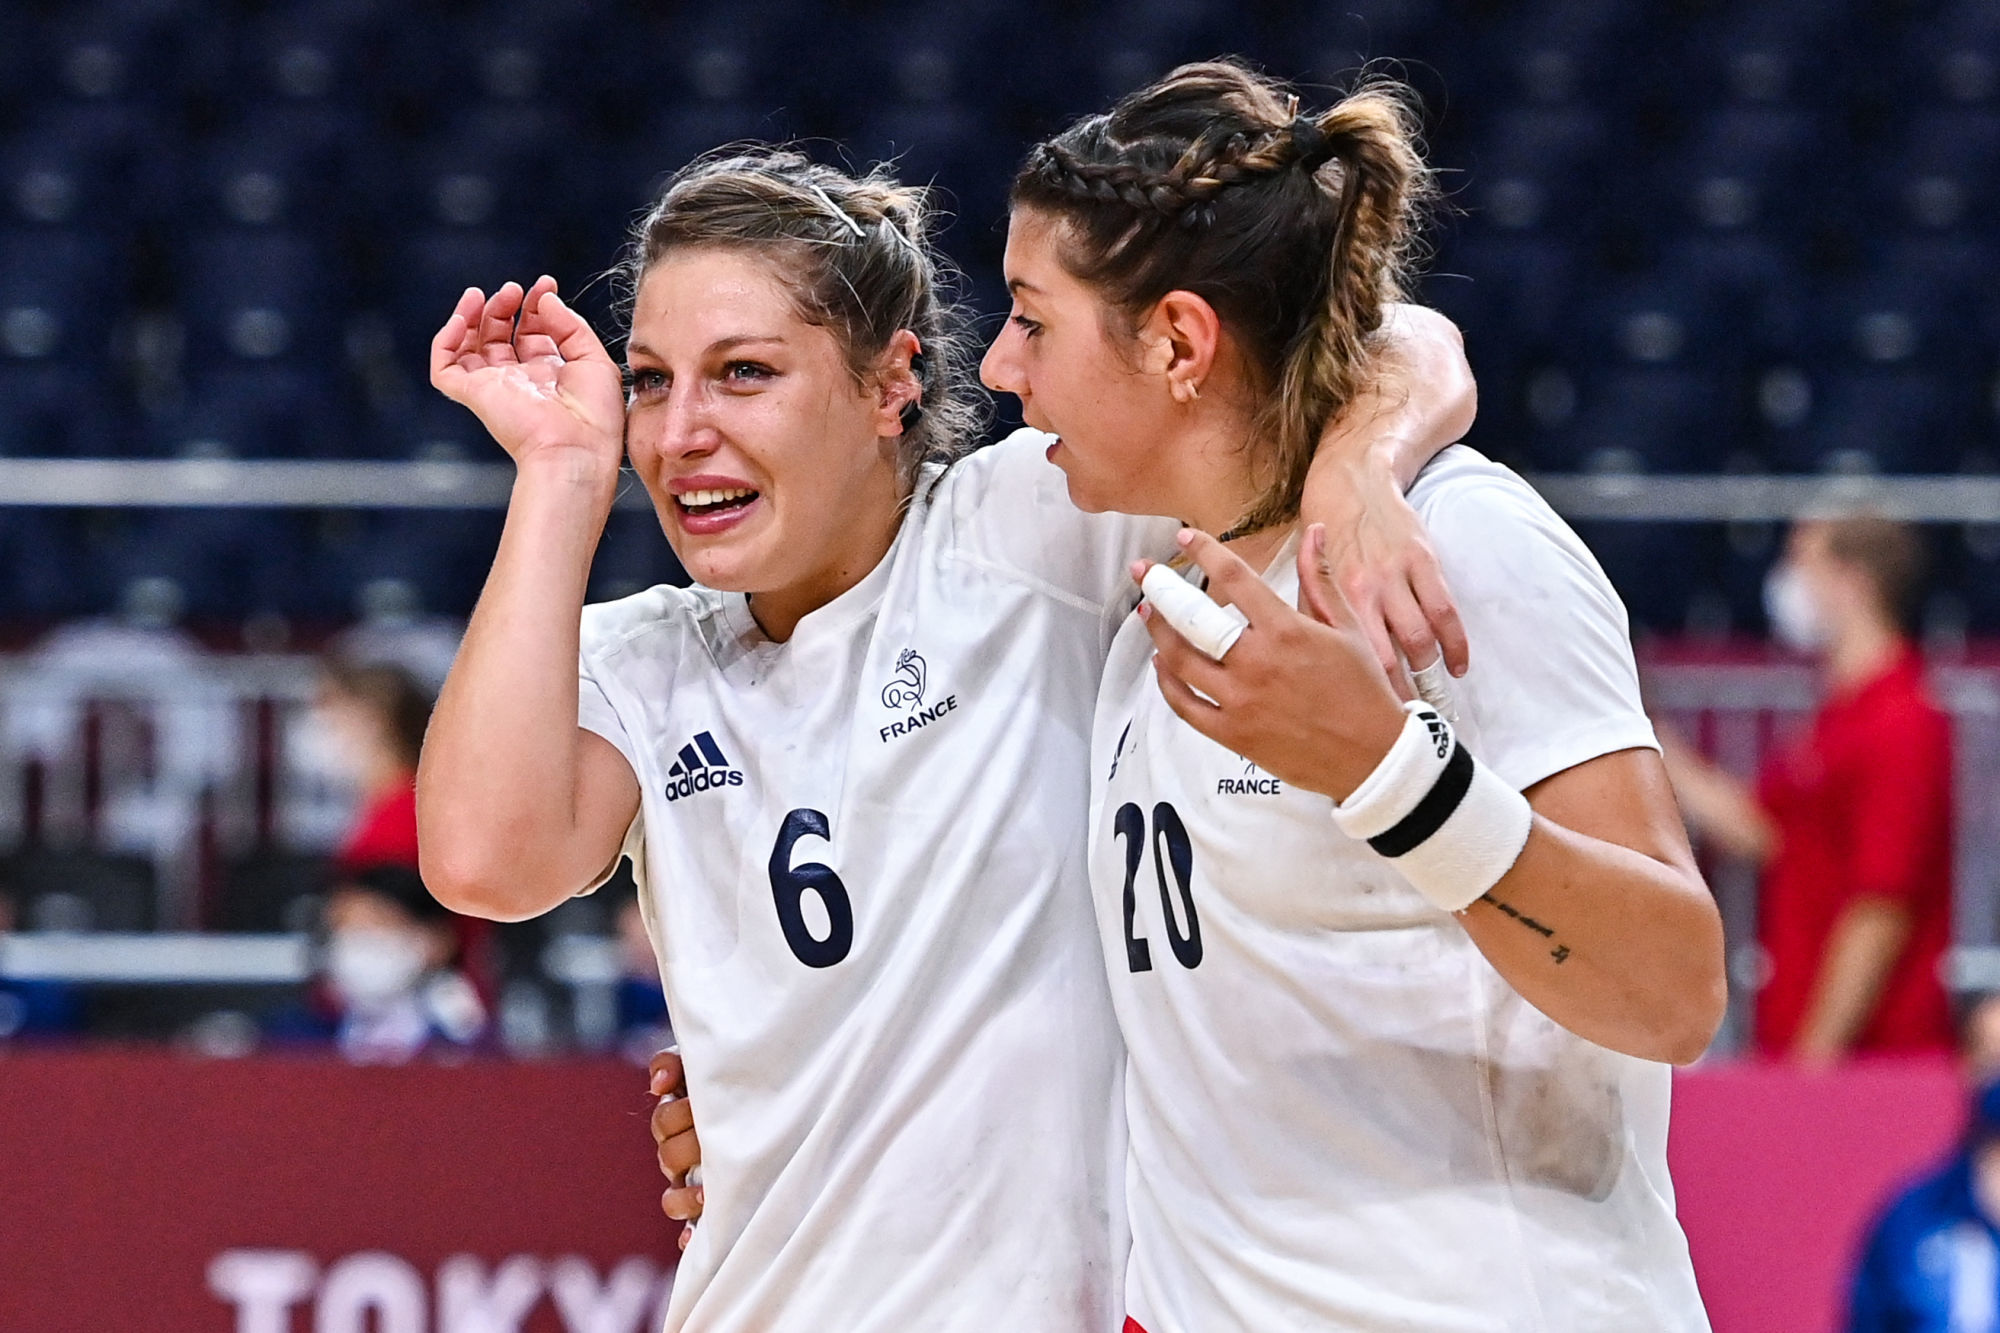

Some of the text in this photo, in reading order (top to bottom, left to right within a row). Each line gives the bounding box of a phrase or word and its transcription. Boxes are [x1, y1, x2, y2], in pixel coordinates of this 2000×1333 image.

[879, 694, 958, 743] FRANCE
[665, 766, 744, 802] adidas
[1217, 779, 1281, 795] FRANCE
[768, 808, 854, 969] 6
[1113, 802, 1204, 973] 20
[206, 1250, 674, 1333] TOKY
